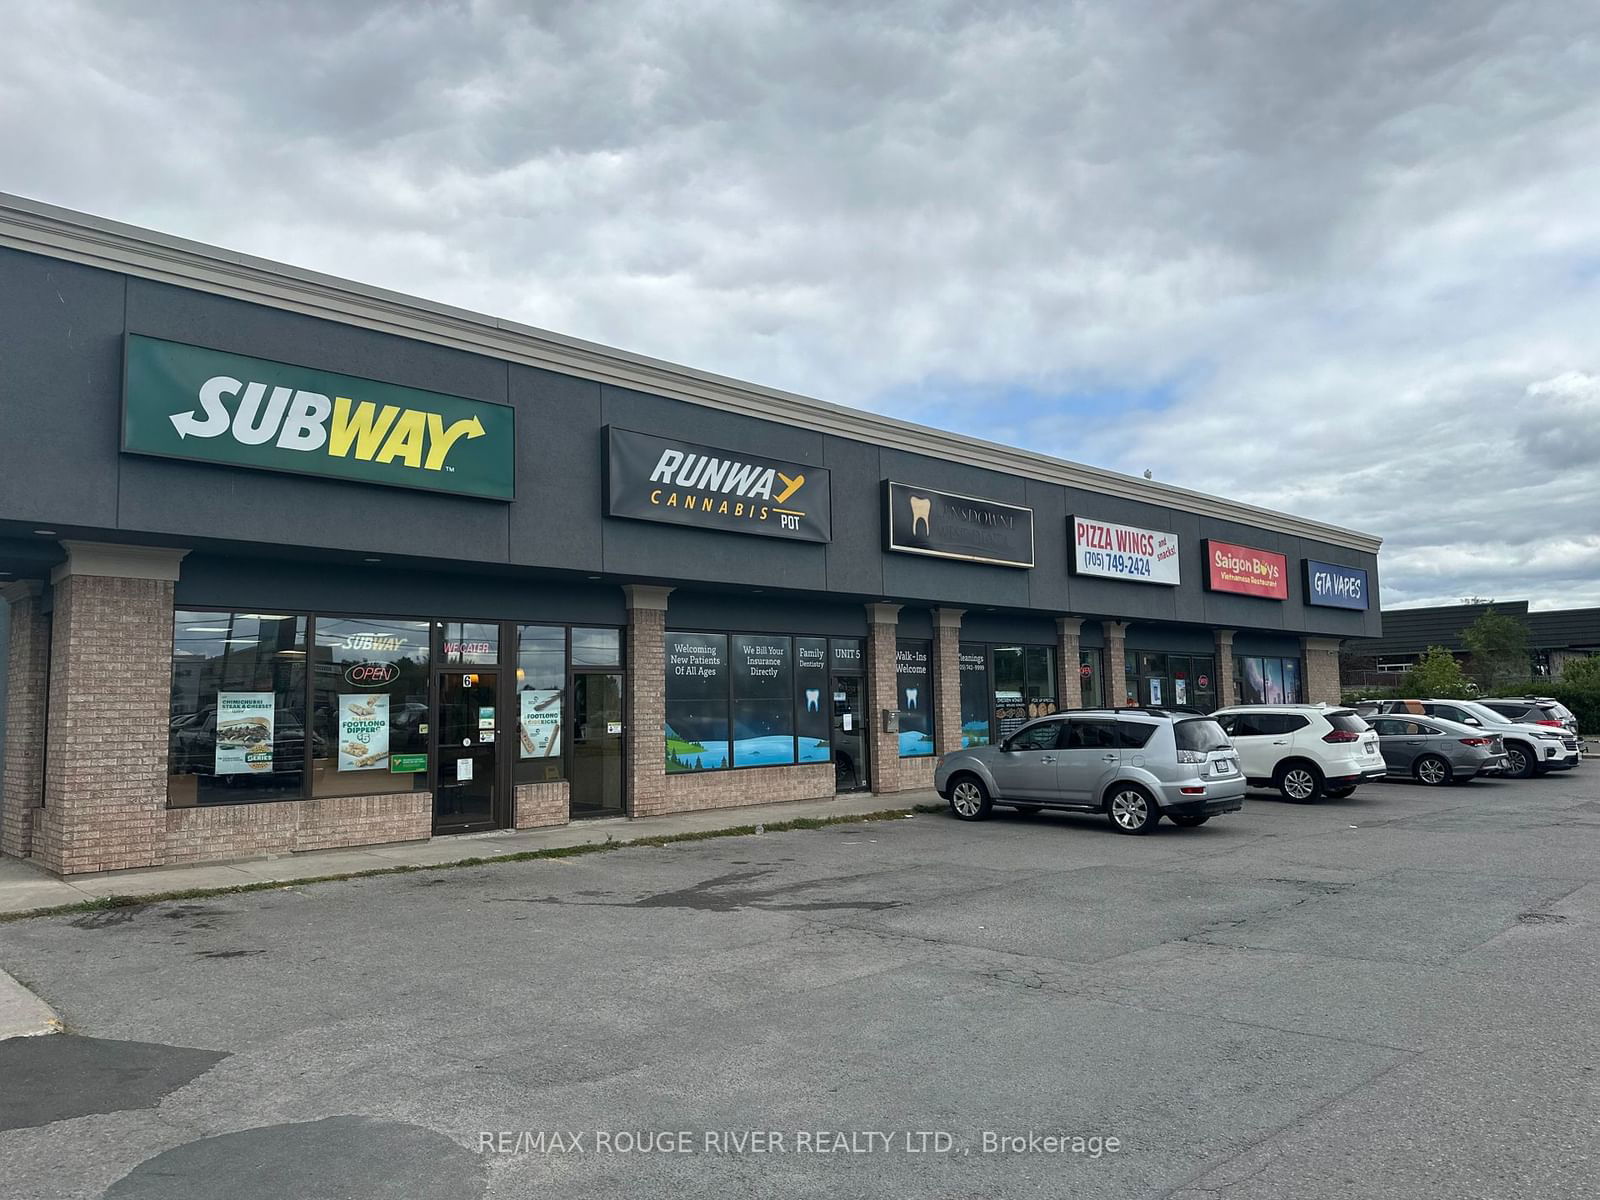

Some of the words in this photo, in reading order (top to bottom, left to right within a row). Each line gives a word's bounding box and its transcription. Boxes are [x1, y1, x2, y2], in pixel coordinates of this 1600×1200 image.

[168, 376, 486, 471] SUBWAY
[650, 448, 805, 504] RUNWAY
[650, 489, 769, 521] CANNABIS
[781, 514, 800, 531] POT
[1077, 523, 1113, 551] PIZZA
[1115, 528, 1154, 557] WINGS
[1158, 537, 1167, 548] and
[1157, 545, 1176, 562] snacks!
[1084, 551, 1104, 571] (705)
[1105, 553, 1150, 577] 749-2424
[1215, 550, 1252, 574] Saigon
[1253, 558, 1279, 579] Boys
[1221, 571, 1250, 584] Vietnamese
[1250, 576, 1277, 587] Restaurant
[1314, 572, 1332, 597] GTA
[1333, 574, 1361, 599] VAPES
[341, 636, 408, 651] SUBWAY
[460, 642, 489, 653] CATER
[674, 643, 717, 656] Welcoming
[743, 645, 755, 655] We
[755, 646, 767, 655] Bill
[768, 646, 784, 655] Your
[799, 648, 824, 660] Family
[835, 649, 855, 659] UNIT
[855, 650, 861, 659] 5
[896, 650, 927, 662] Walk-Ins
[670, 655, 689, 664] New
[689, 655, 720, 665] Patients
[747, 656, 781, 666] Insurance
[799, 660, 825, 669] Dentistry
[959, 653, 984, 664] leanings
[352, 666, 392, 681] OPEN
[675, 666, 685, 675] Of
[686, 666, 697, 676] All
[698, 667, 716, 678] Ages
[750, 667, 778, 678] Directly
[896, 664, 927, 674] Welcome
[464, 675, 471, 687] 6
[342, 720, 385, 728] FOOTLONG
